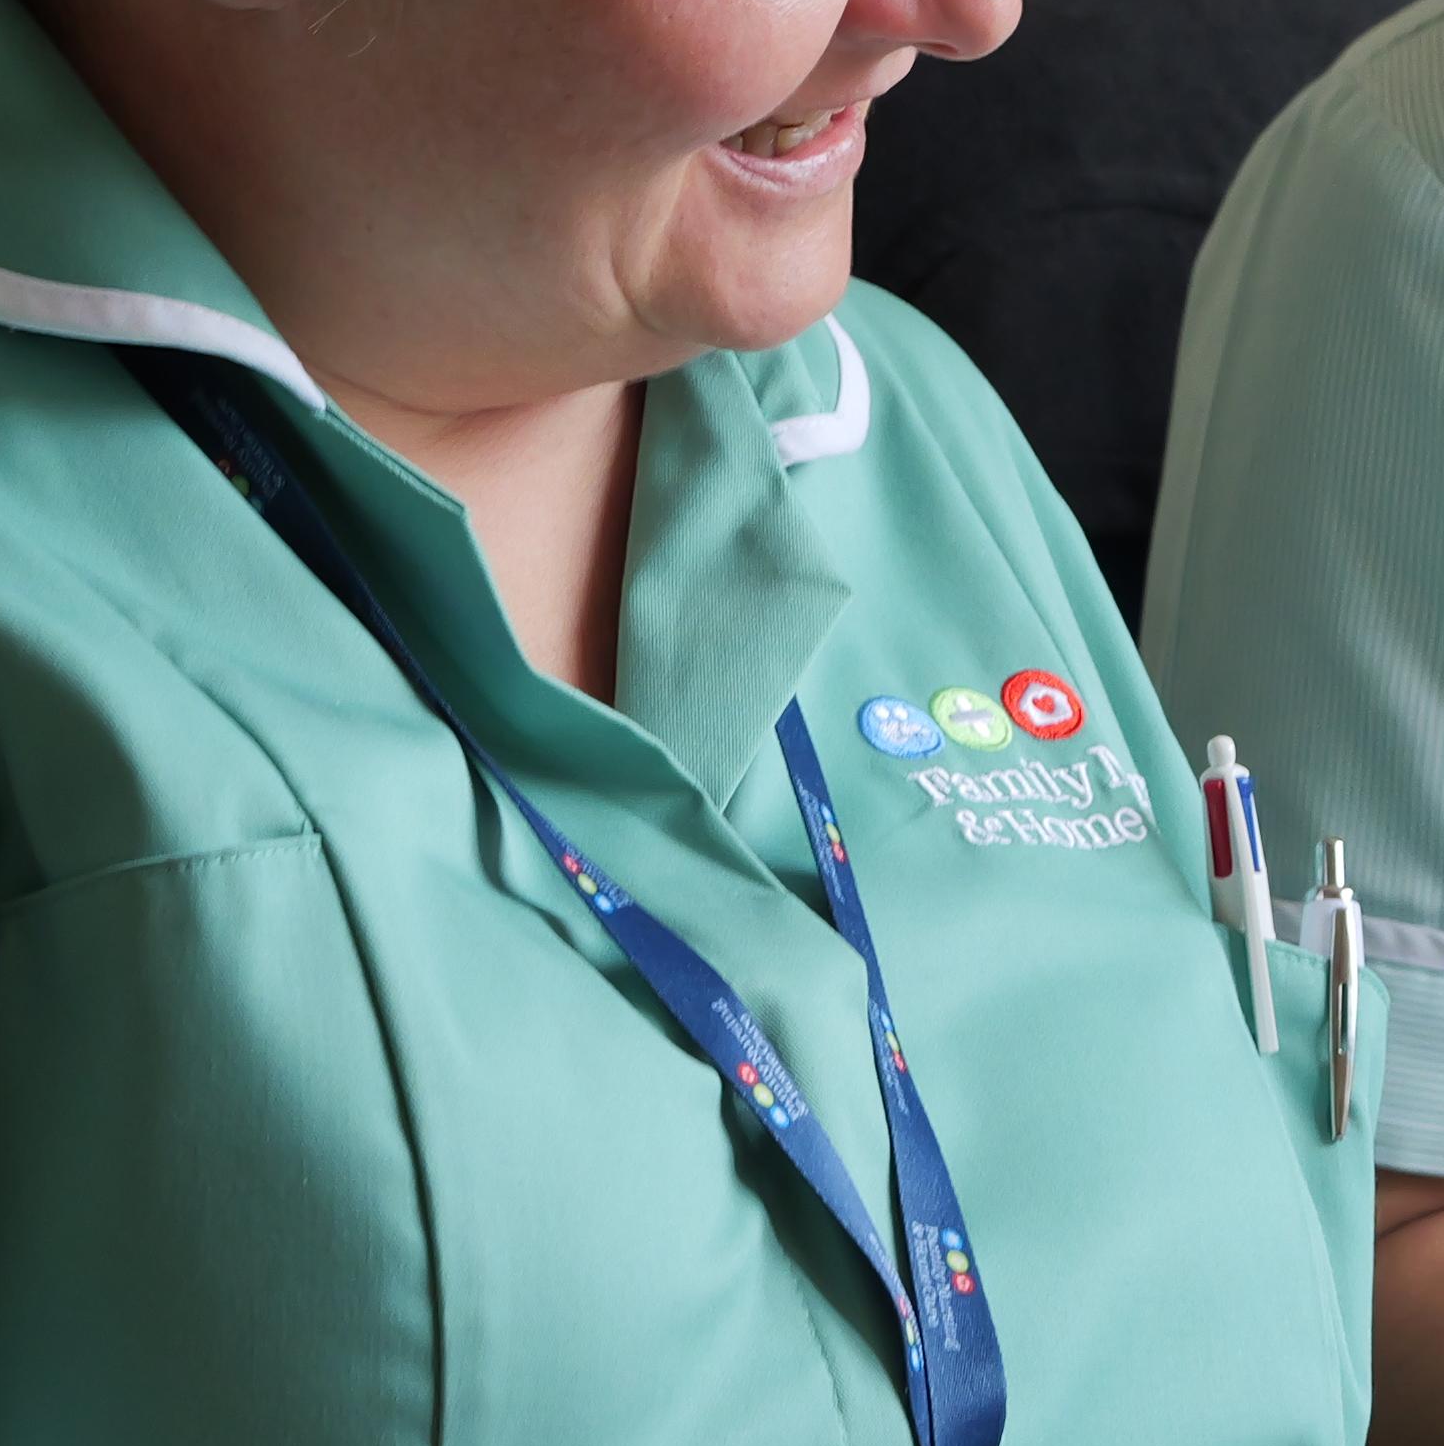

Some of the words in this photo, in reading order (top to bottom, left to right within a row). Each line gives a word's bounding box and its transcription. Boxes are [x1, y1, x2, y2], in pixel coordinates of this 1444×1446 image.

[908, 758, 1095, 809] Family
[956, 809, 1004, 846] &
[1002, 805, 1150, 850] Home
